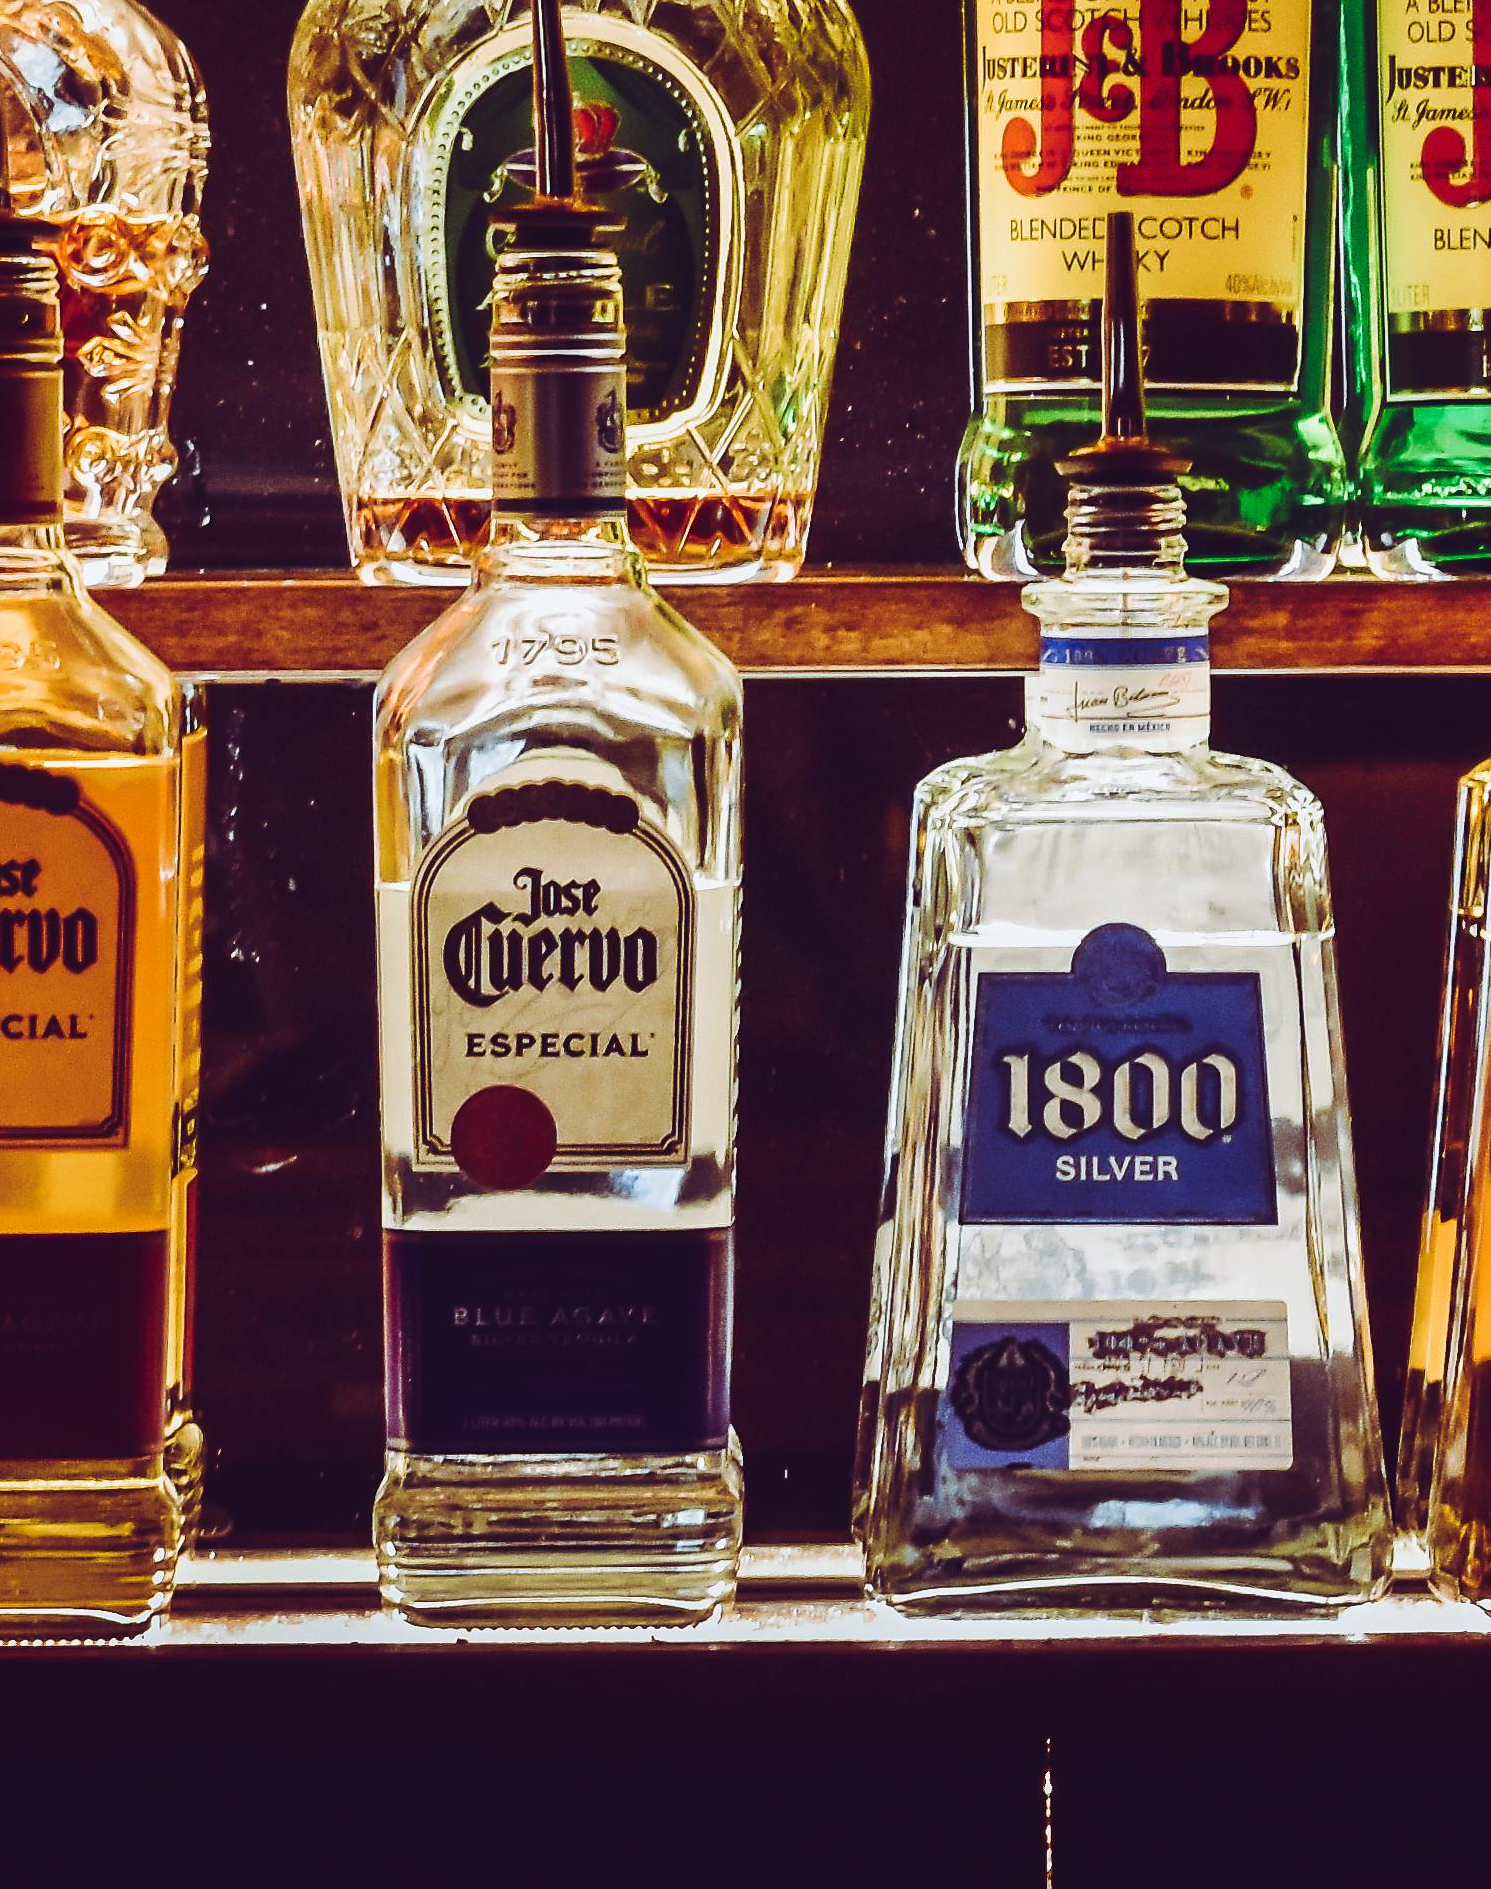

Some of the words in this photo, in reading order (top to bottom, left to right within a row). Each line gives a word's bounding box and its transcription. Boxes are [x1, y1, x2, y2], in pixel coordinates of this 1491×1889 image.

[992, 11, 1027, 33] OLD
[1035, 9, 1142, 33] SCOTCH
[1407, 21, 1456, 43] OLD
[1138, 218, 1239, 240] COTCH
[493, 635, 621, 666] 1795
[1122, 722, 1134, 731] EN
[513, 868, 601, 927] Jose
[443, 900, 658, 1008] Cuervo
[465, 1032, 648, 1059] ESPECIAL
[1002, 1050, 1238, 1140] 1800
[1056, 1155, 1179, 1182] SILVER
[452, 1305, 538, 1327] BLUE
[550, 1304, 656, 1326] AGAVE
